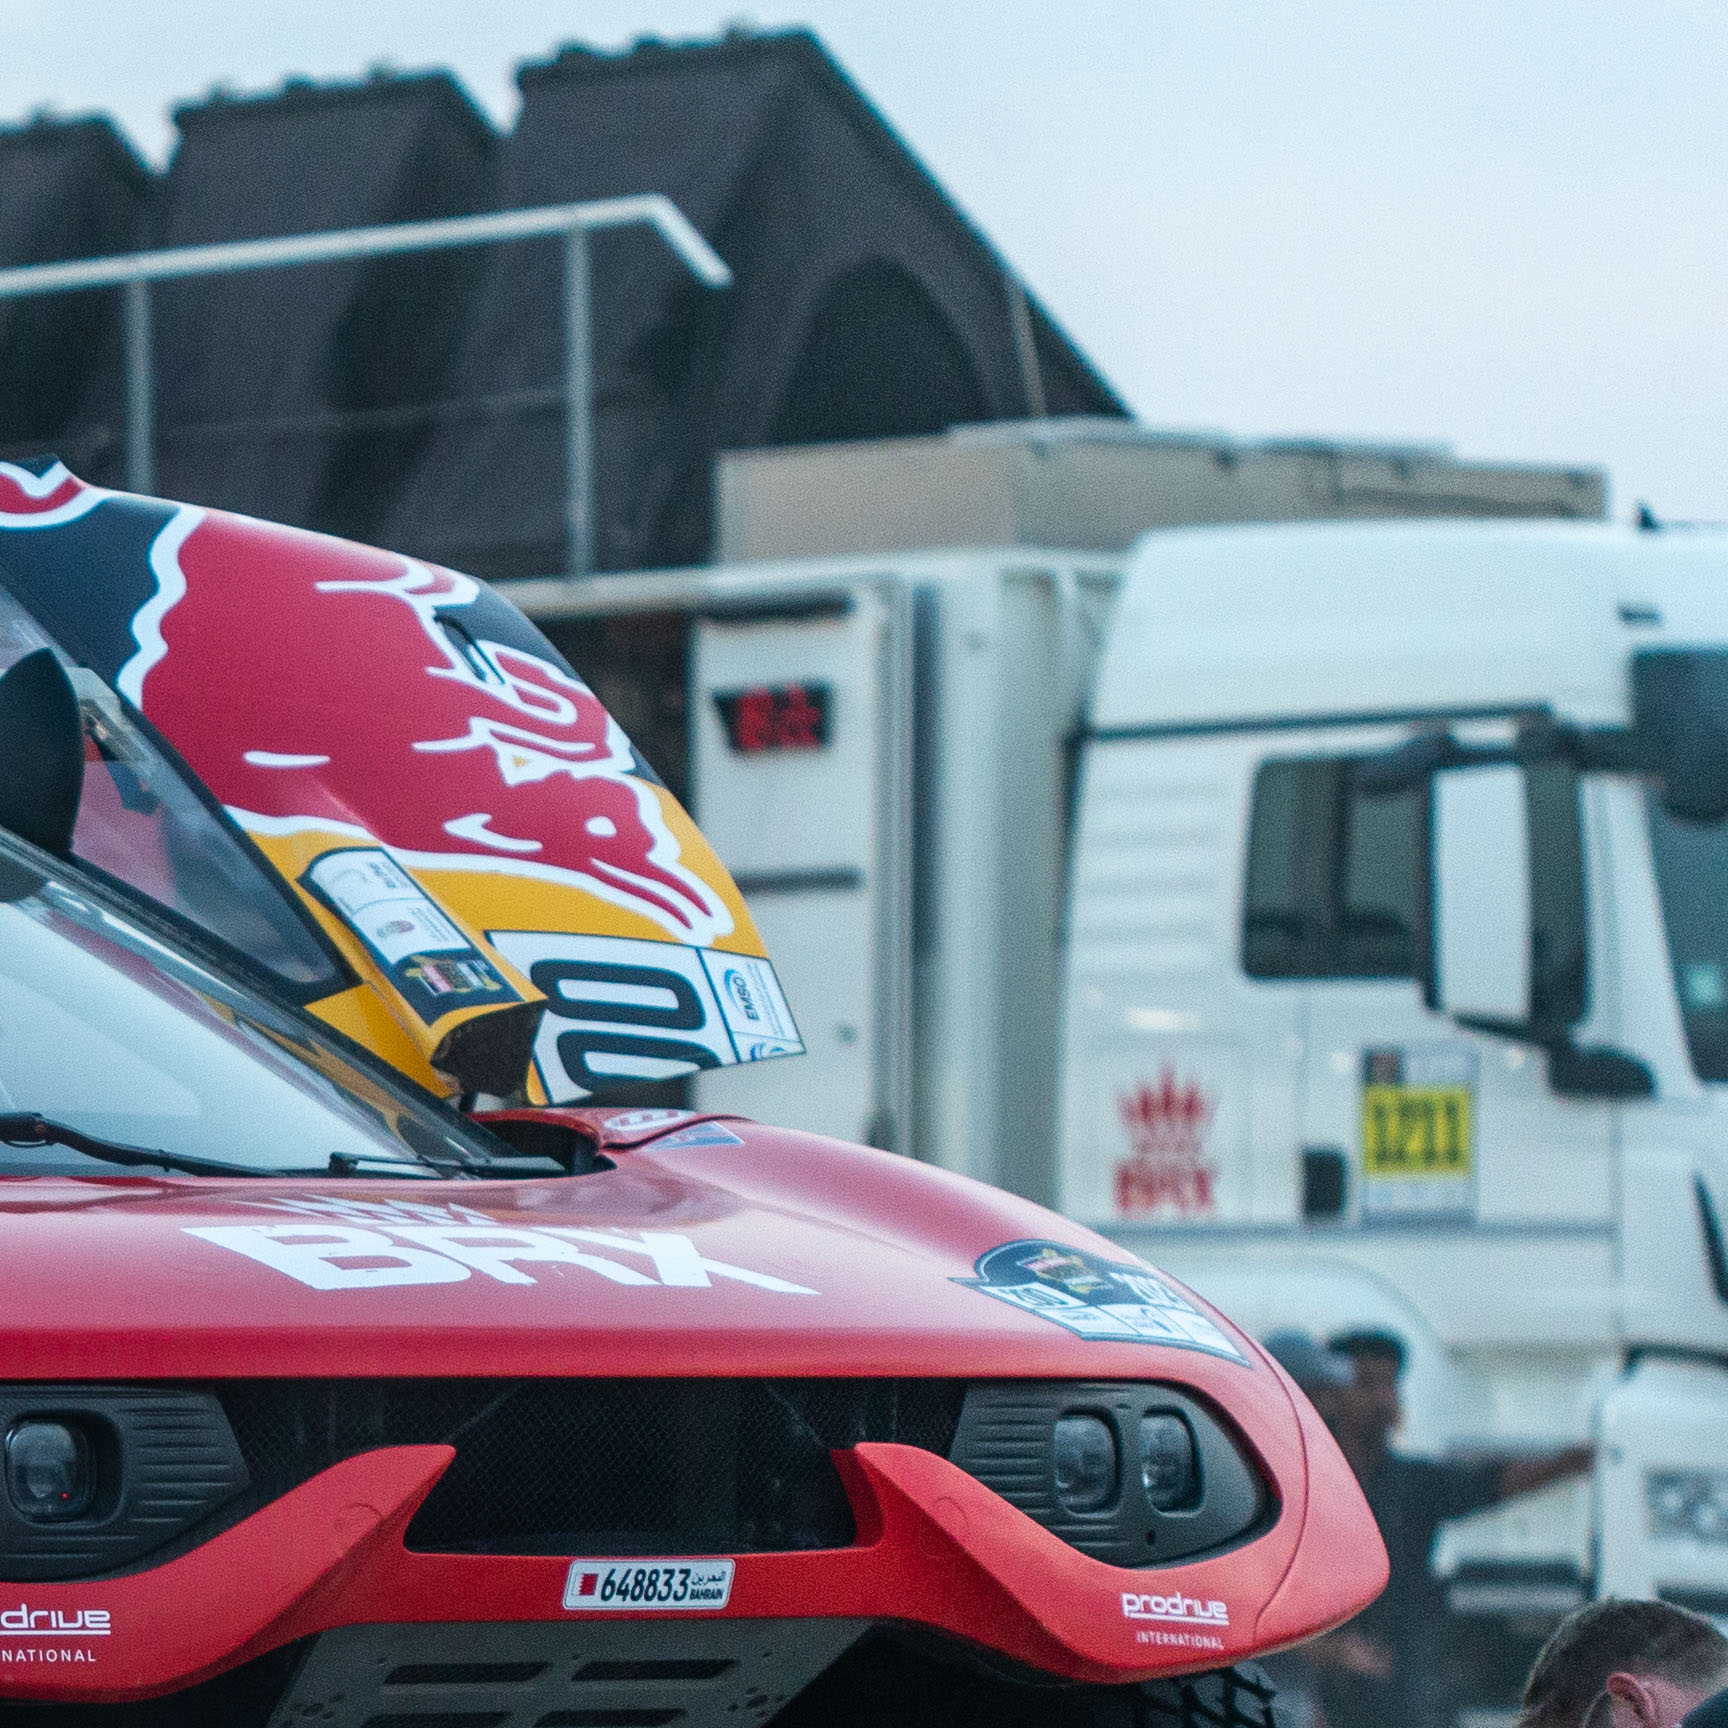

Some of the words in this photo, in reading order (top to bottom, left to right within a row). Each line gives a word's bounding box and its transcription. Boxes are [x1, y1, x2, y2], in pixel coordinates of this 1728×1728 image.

[531, 959, 722, 1094] 00
[179, 1225, 823, 1296] BRX
[600, 1568, 692, 1602] 648833
[689, 1588, 724, 1601] BAHRAIN
[1121, 1590, 1230, 1625] prodrive
[1135, 1631, 1225, 1650] INTERNATIONAL
